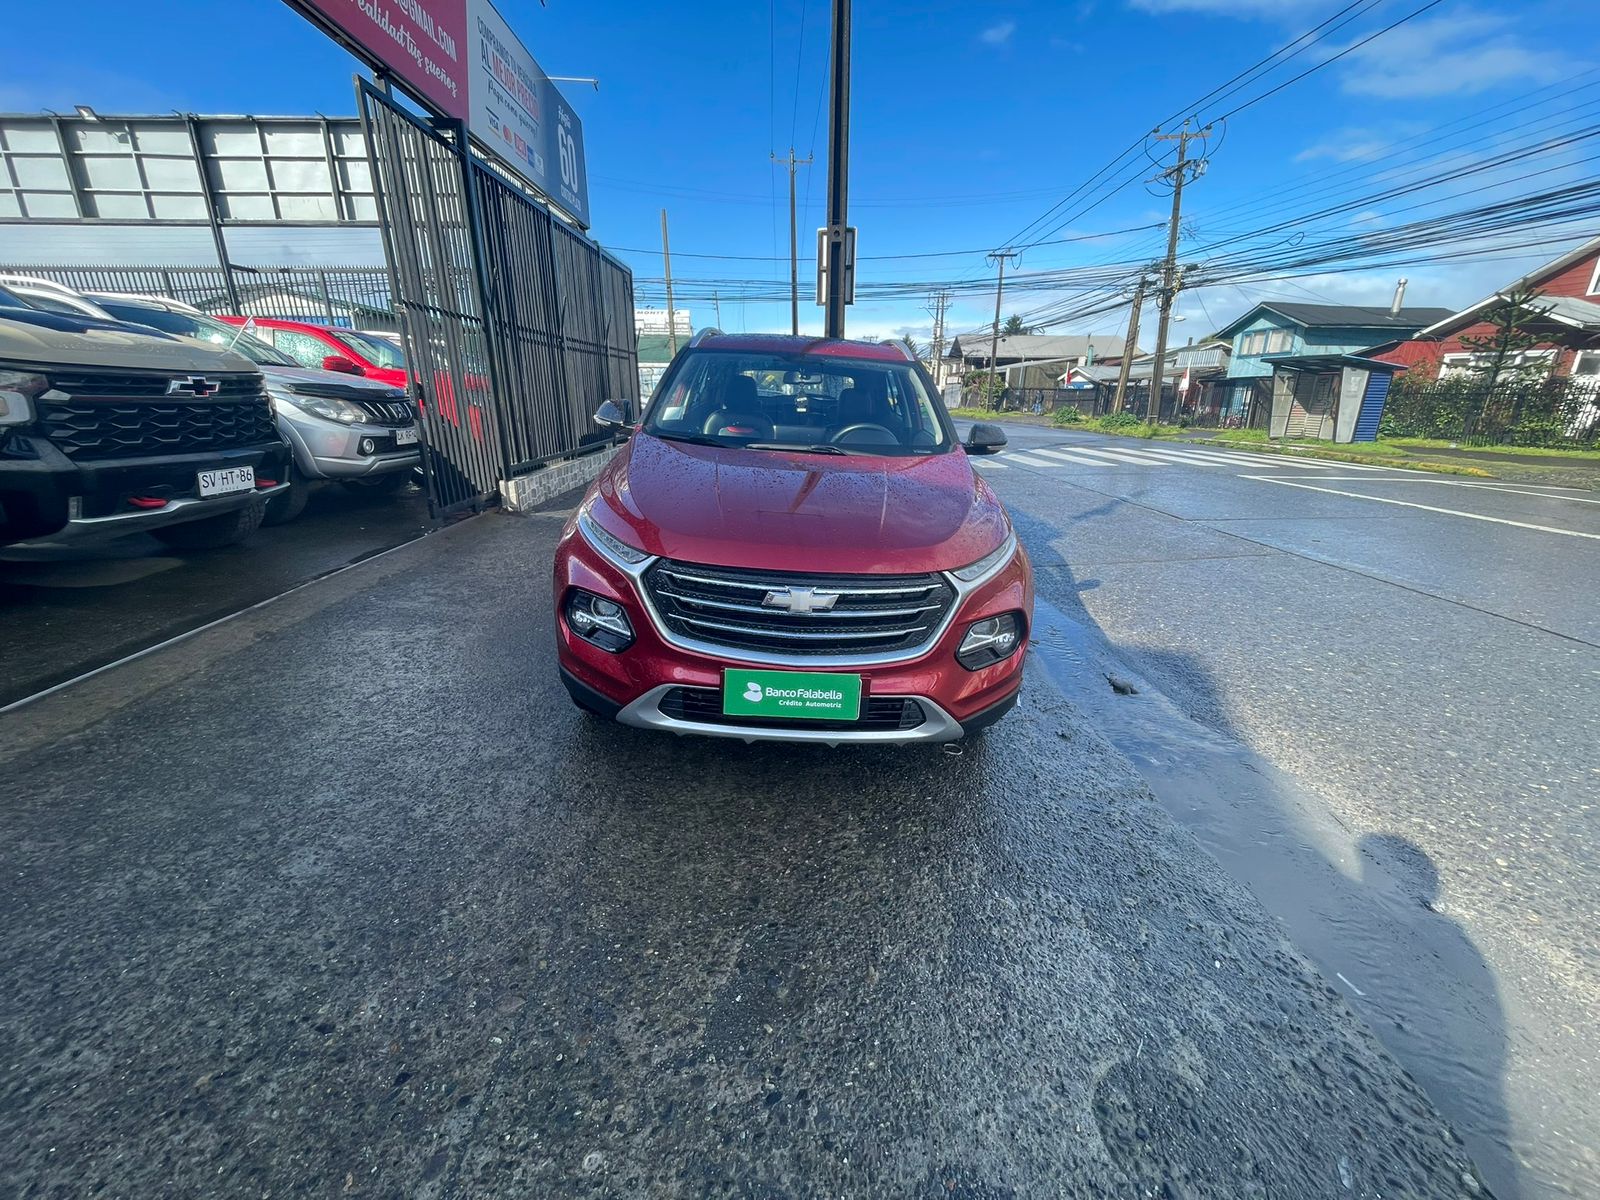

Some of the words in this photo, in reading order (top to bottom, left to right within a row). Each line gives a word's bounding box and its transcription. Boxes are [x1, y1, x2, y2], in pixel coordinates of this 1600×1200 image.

[480, 38, 492, 71] AL
[491, 50, 517, 98] MEJOR
[516, 78, 539, 120] PRECIO
[487, 112, 499, 131] VISA
[557, 123, 578, 194] 60
[778, 699, 803, 707] Crédito
[805, 700, 842, 709] Automotriz
